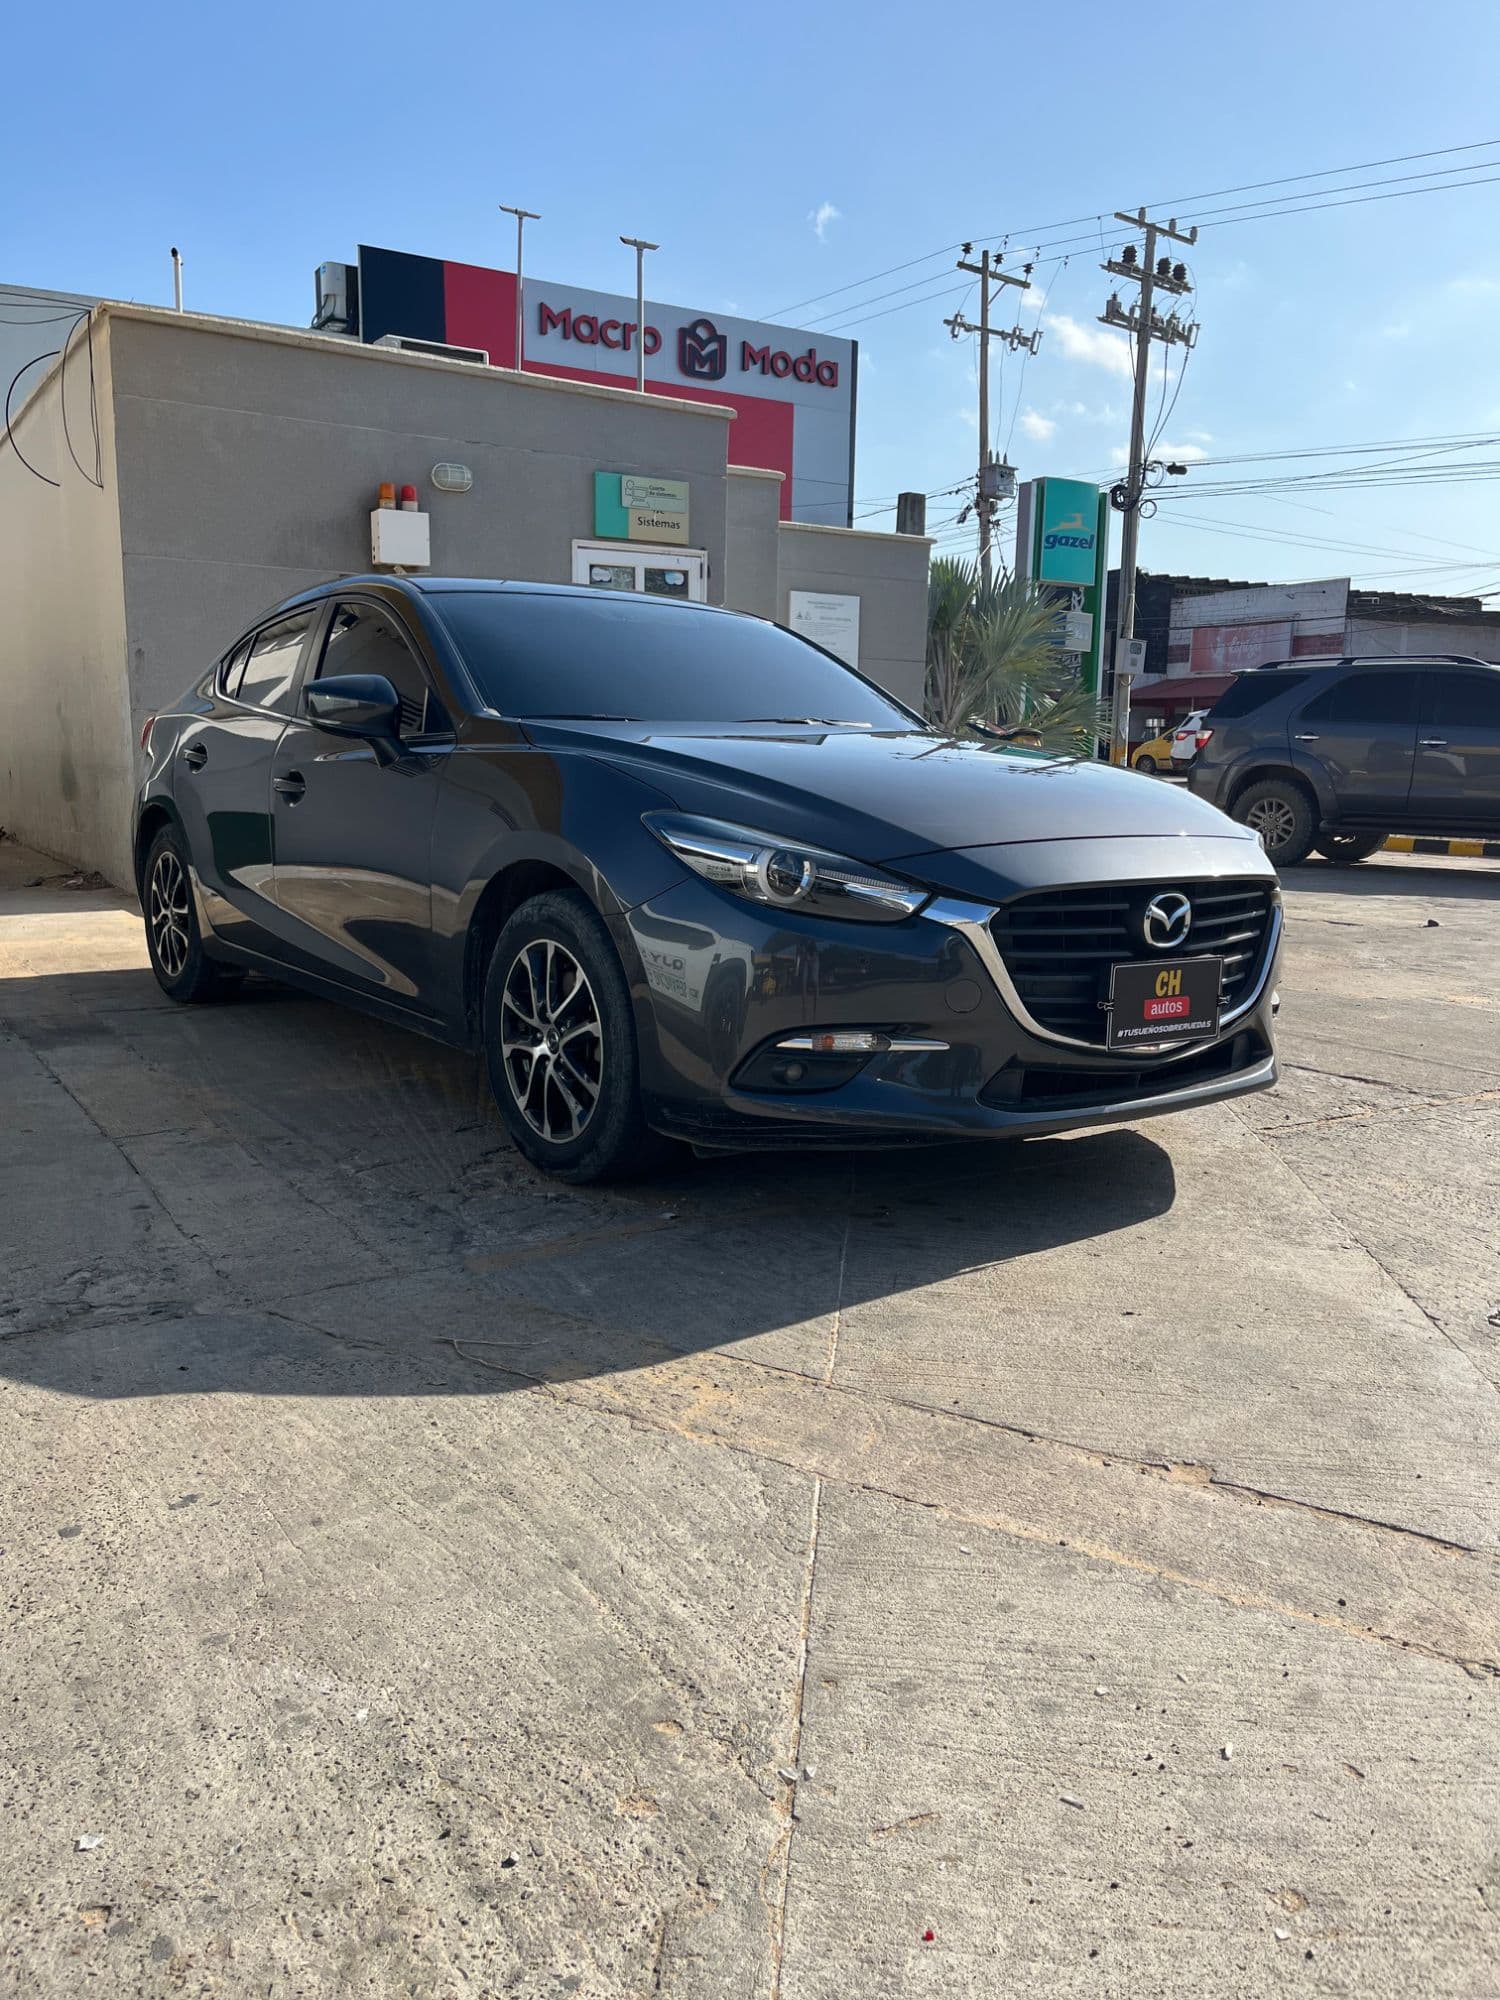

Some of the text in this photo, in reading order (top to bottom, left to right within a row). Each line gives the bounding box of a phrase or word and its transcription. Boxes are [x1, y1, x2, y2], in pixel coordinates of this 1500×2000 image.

[540, 302, 662, 355] Macro
[741, 340, 839, 387] Moda
[637, 516, 681, 530] Sistemas
[1044, 534, 1095, 549] gazel
[1155, 969, 1182, 997] CH
[1151, 1000, 1183, 1015] autos
